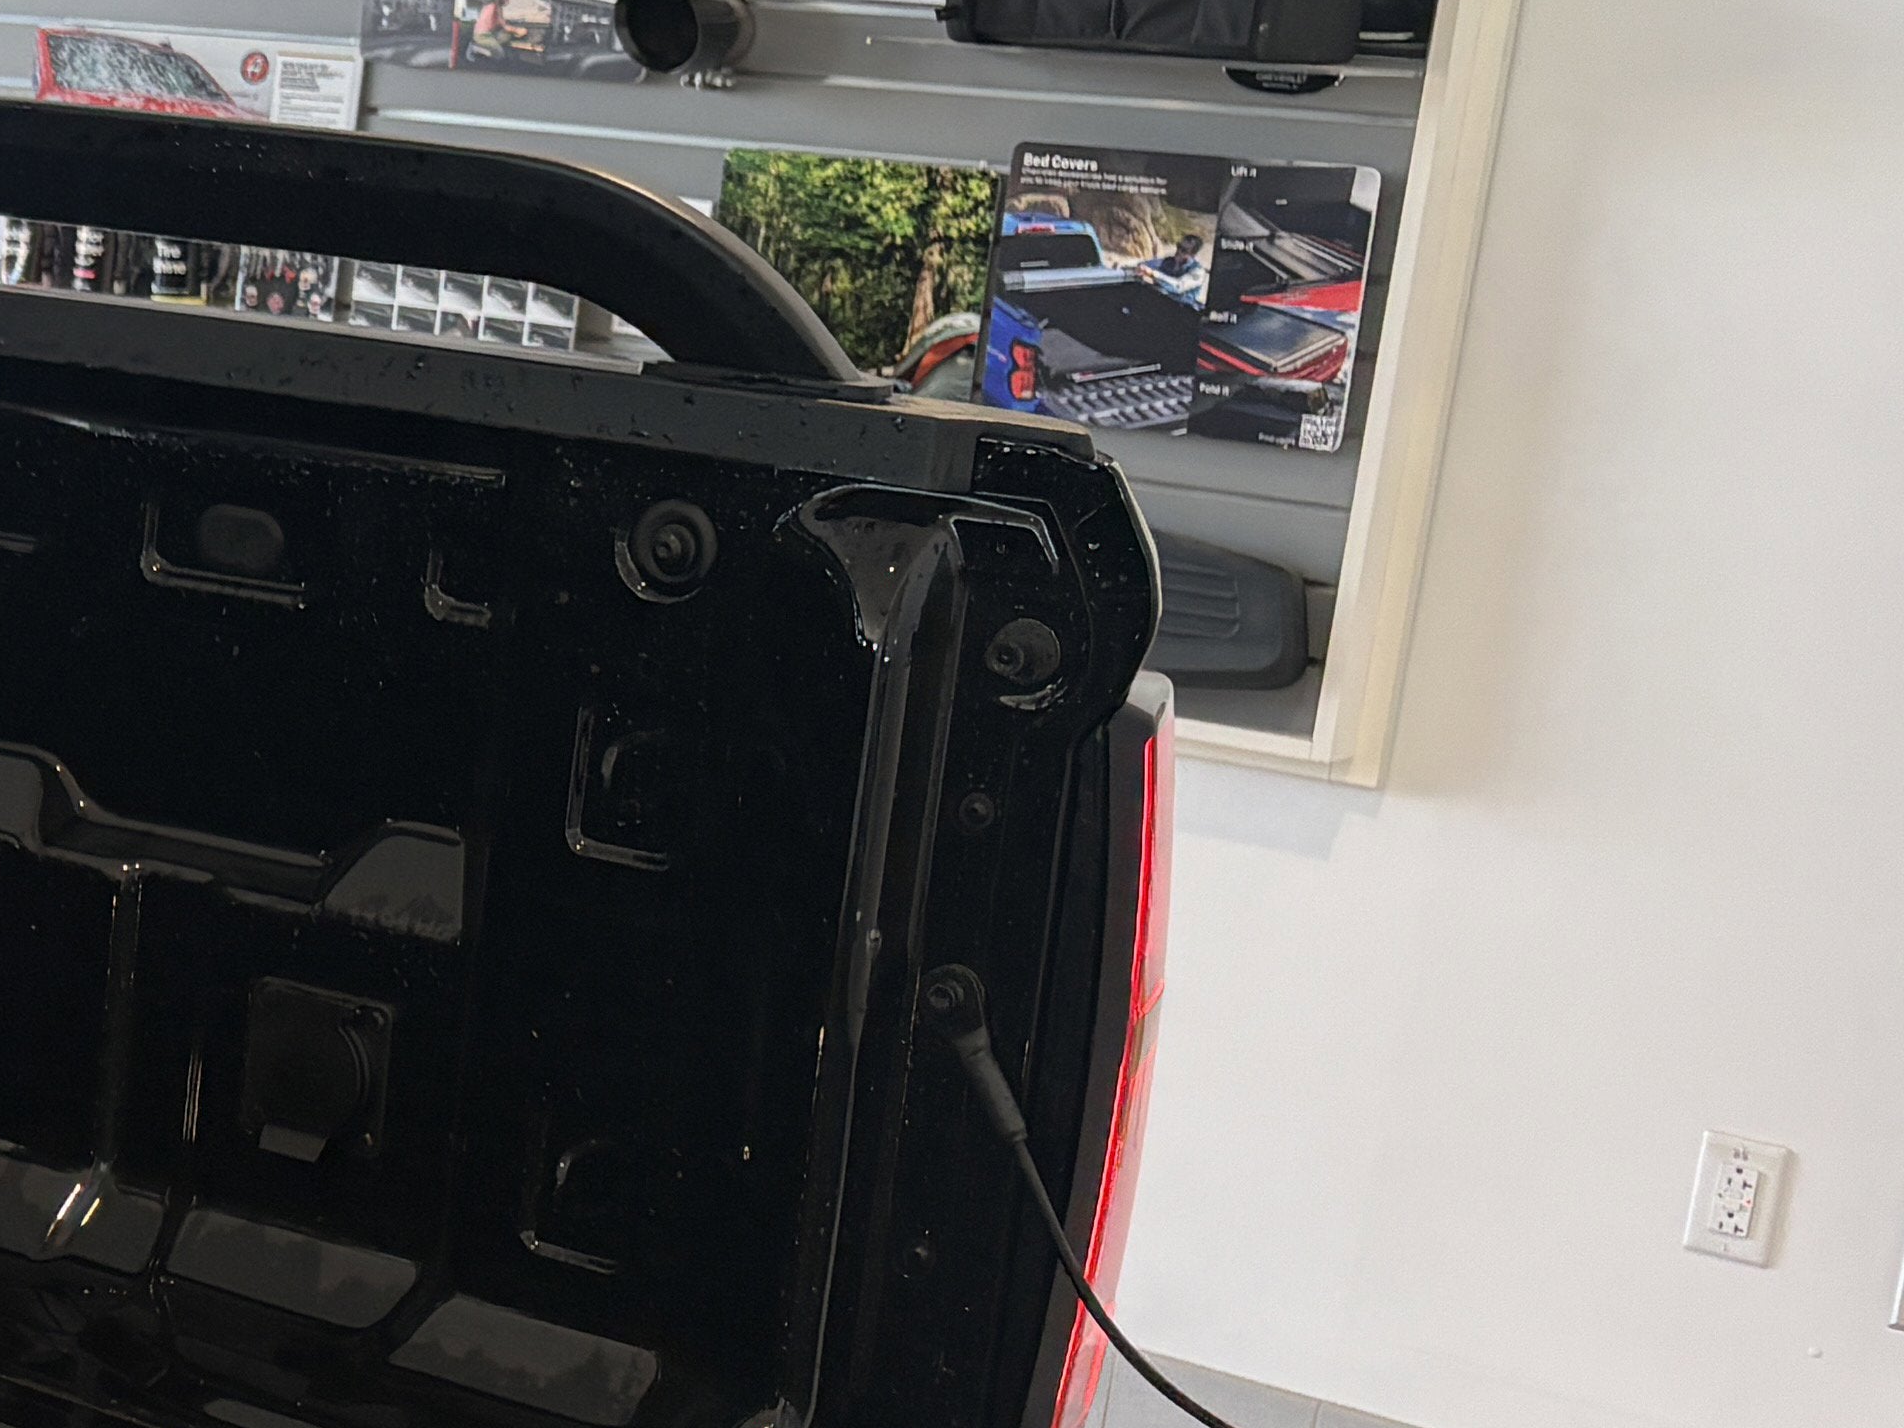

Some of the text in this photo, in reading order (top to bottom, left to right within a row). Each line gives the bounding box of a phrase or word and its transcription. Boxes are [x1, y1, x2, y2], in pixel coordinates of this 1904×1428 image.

[1023, 152, 1098, 172] Bed Covers
[1231, 166, 1257, 178] Lift it
[1221, 237, 1244, 251] Slide
[1209, 310, 1229, 323] Roll
[1199, 382, 1230, 396] Fold it
